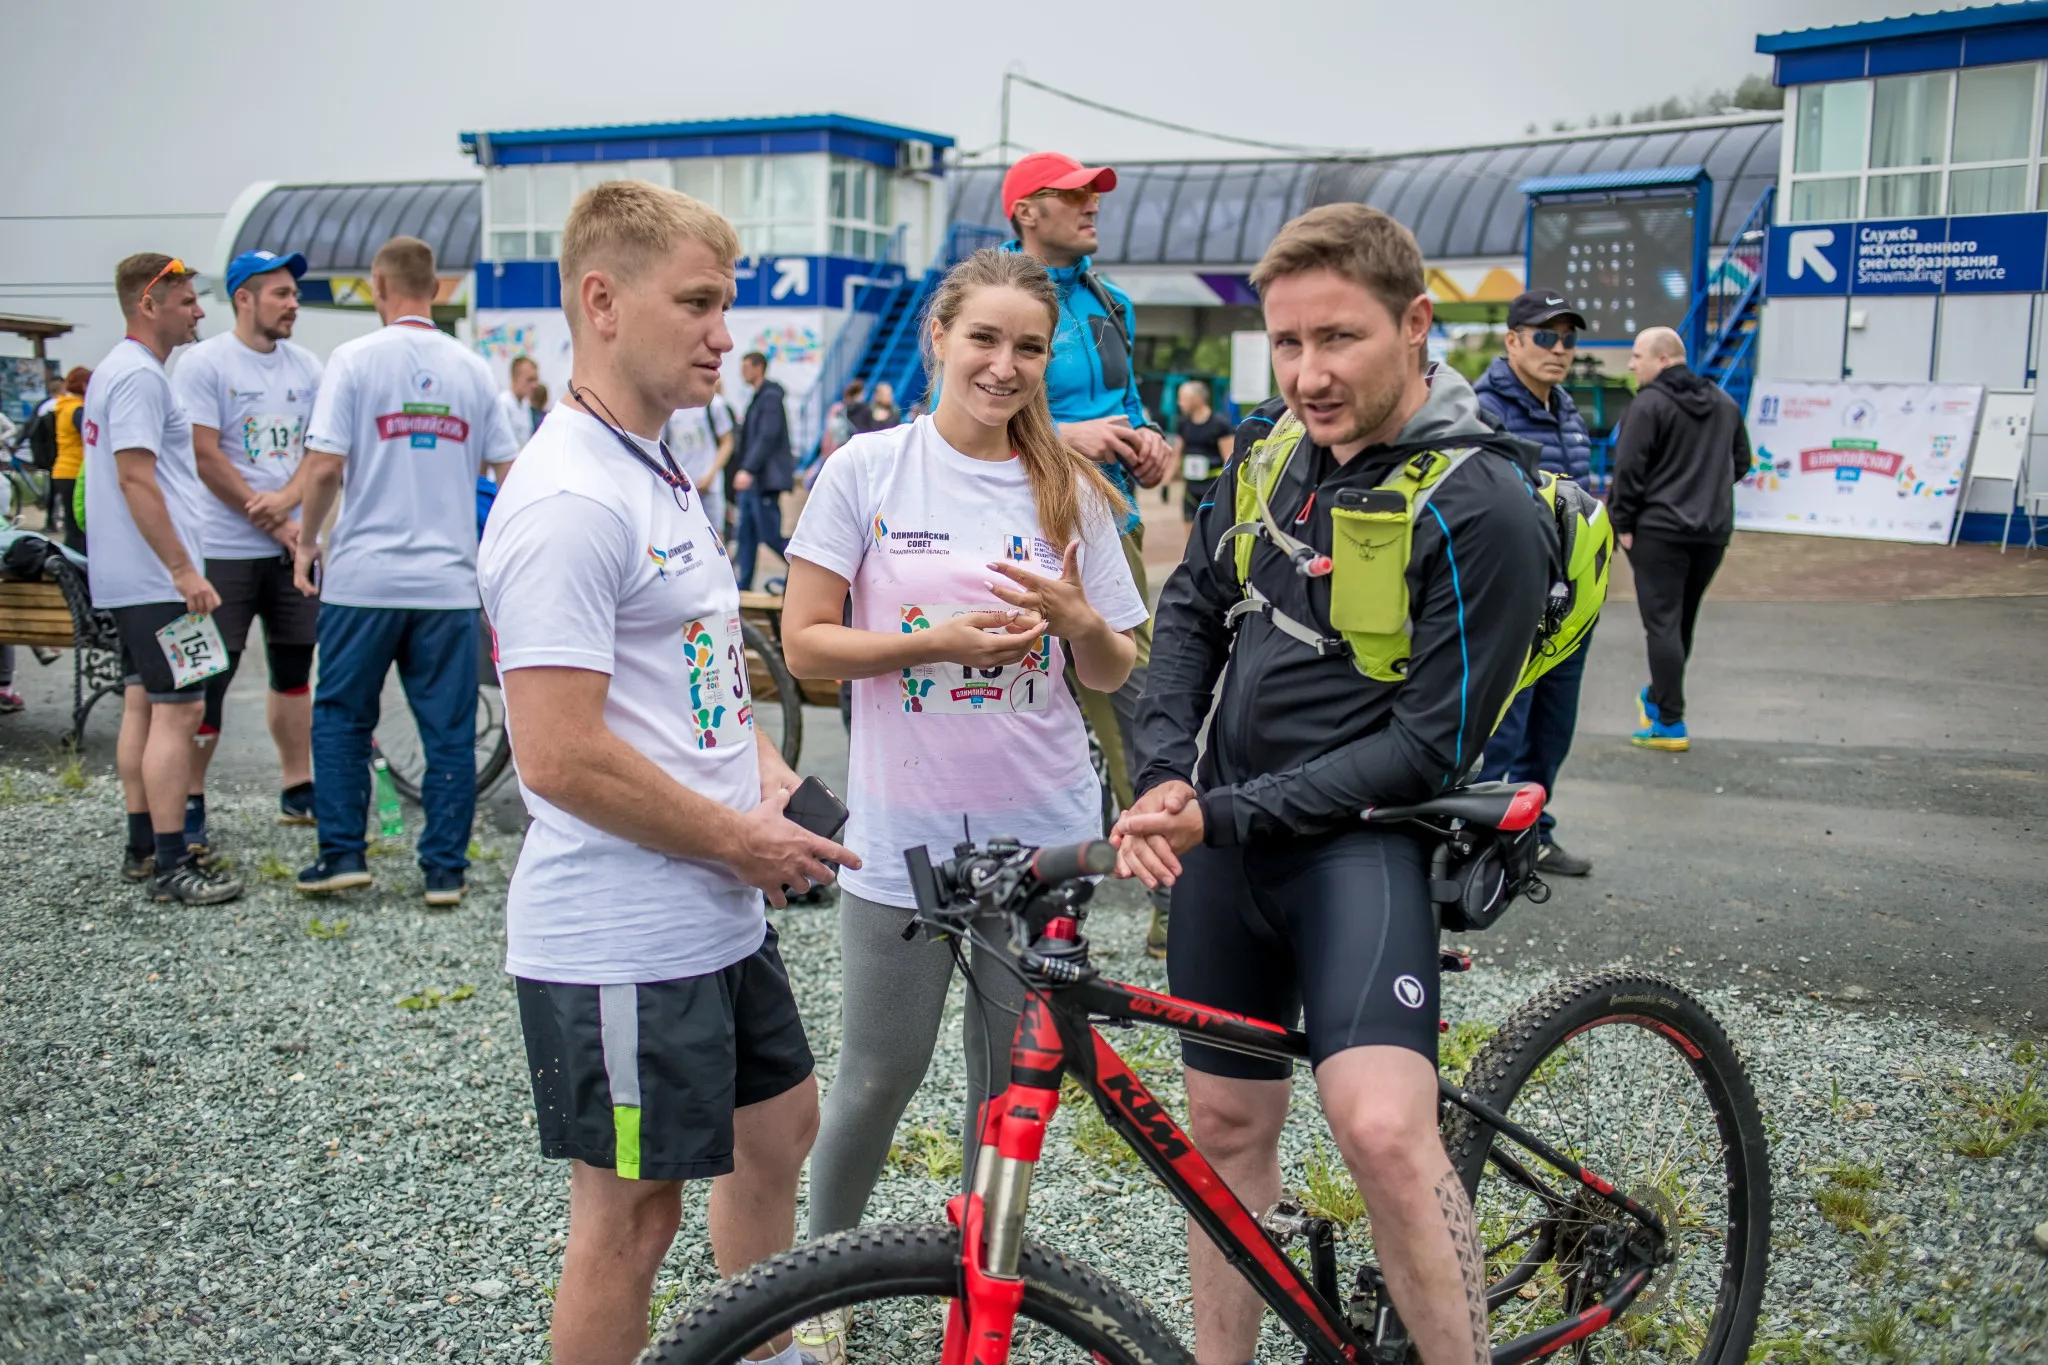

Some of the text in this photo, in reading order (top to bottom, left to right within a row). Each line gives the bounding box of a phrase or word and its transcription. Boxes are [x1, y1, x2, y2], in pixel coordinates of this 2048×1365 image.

[1860, 227, 1918, 244] Служба
[1859, 241, 1977, 258] искусственного
[1858, 255, 1998, 273] снегообразования
[1858, 267, 2006, 284] Snowmaking service
[1761, 396, 1780, 418] 01
[270, 427, 288, 447] 13
[891, 531, 950, 541] ОЛИМПИЙСКИЙ
[907, 540, 931, 548] СОВЕТ
[181, 630, 211, 669] 154
[955, 688, 998, 698] ОЛИМПИЙСКИЙ
[1026, 678, 1034, 704] 1
[1103, 1073, 1189, 1160] KTM
